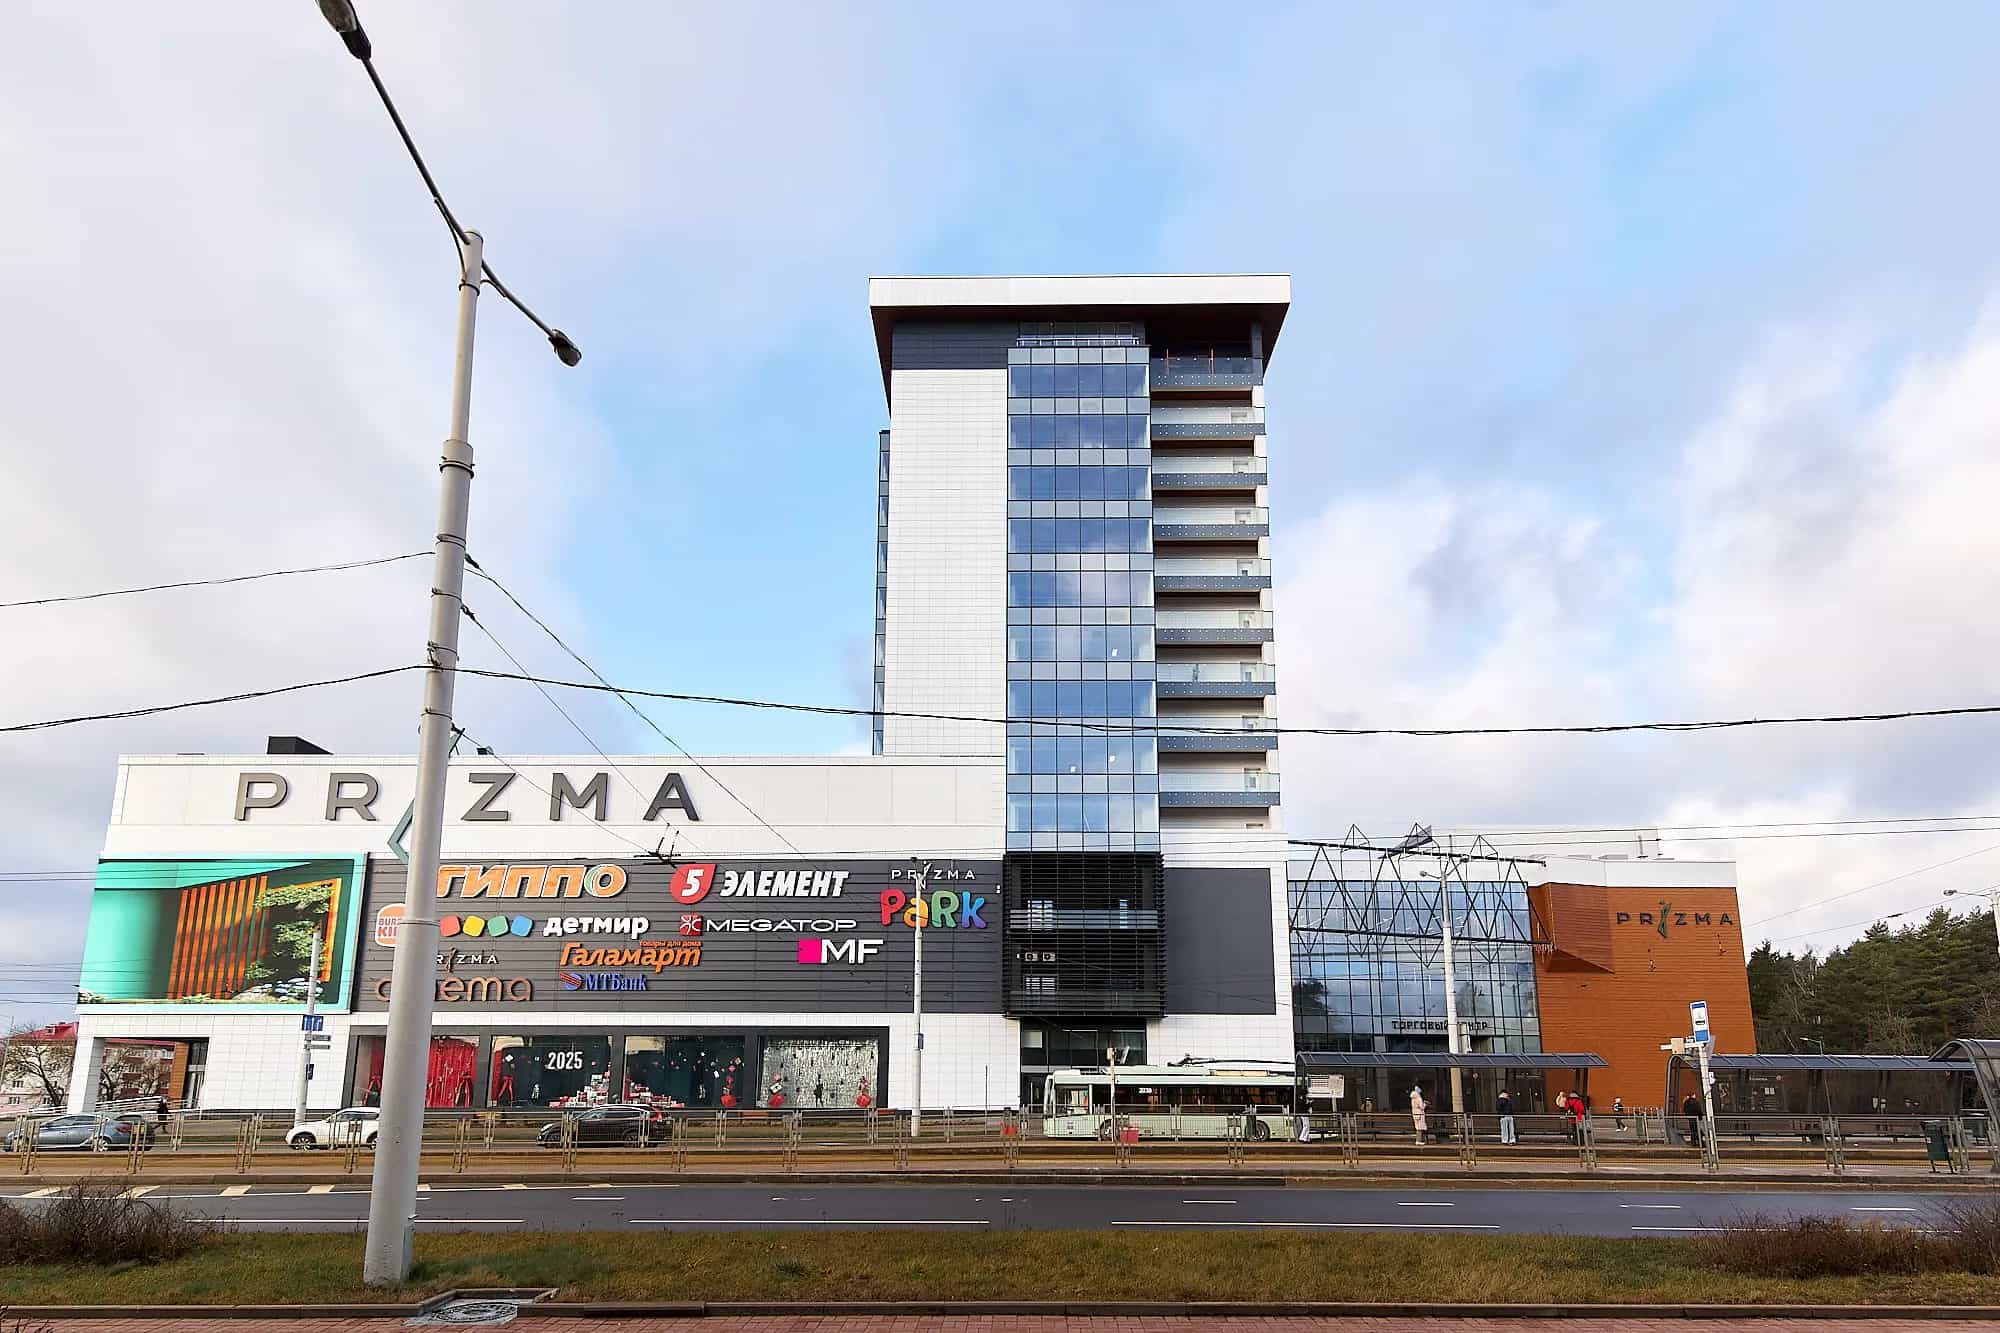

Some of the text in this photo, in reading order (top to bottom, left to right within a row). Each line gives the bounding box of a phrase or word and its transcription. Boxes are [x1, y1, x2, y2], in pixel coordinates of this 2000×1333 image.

[437, 865, 627, 898] ГИППО
[681, 869, 849, 897] 5 ЭЛЕМЕНТ
[543, 917, 649, 939] детмир
[706, 919, 857, 932] MEGATOP
[560, 942, 701, 973] Галамарт
[821, 939, 884, 964] MF
[375, 976, 533, 1002] cema
[585, 973, 647, 991] МТБанк
[547, 1051, 583, 1070] 2025
